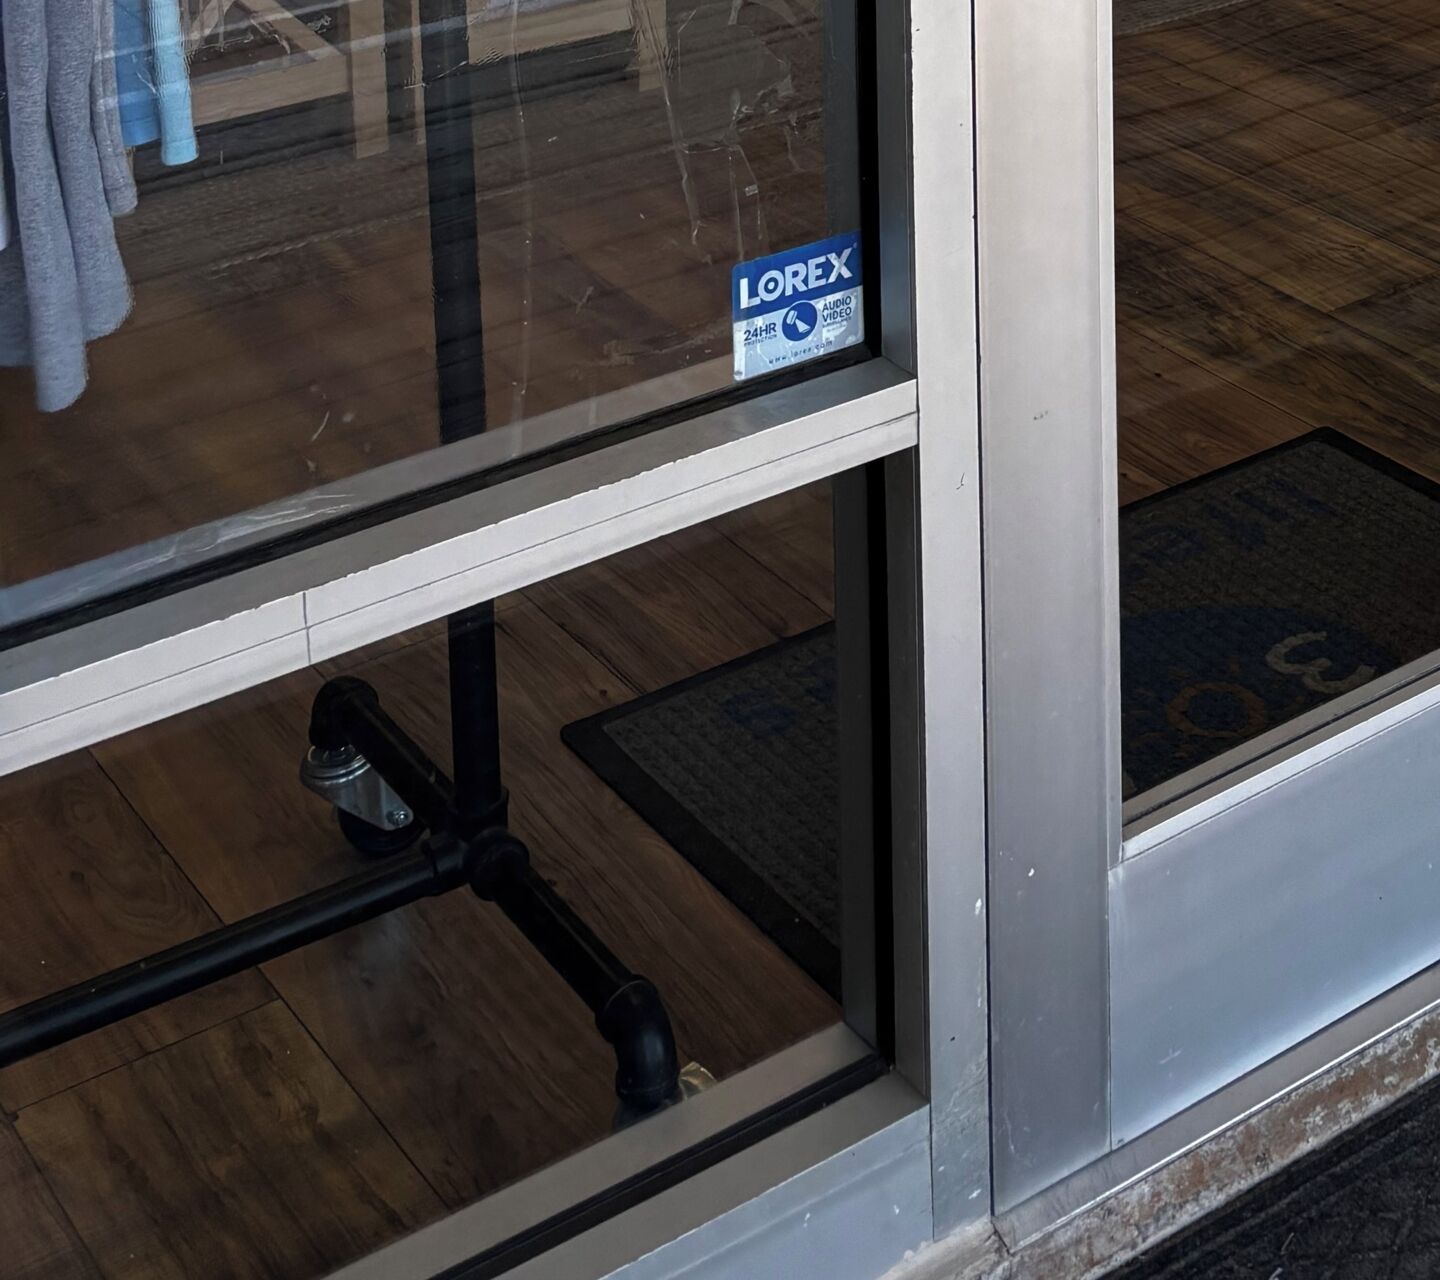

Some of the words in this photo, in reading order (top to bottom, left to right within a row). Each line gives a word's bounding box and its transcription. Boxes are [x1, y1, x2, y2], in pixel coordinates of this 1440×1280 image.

[739, 247, 853, 309] LOREX
[822, 295, 852, 313] AUDIO
[822, 306, 852, 323] VIDEO
[744, 322, 777, 342] 24HR
